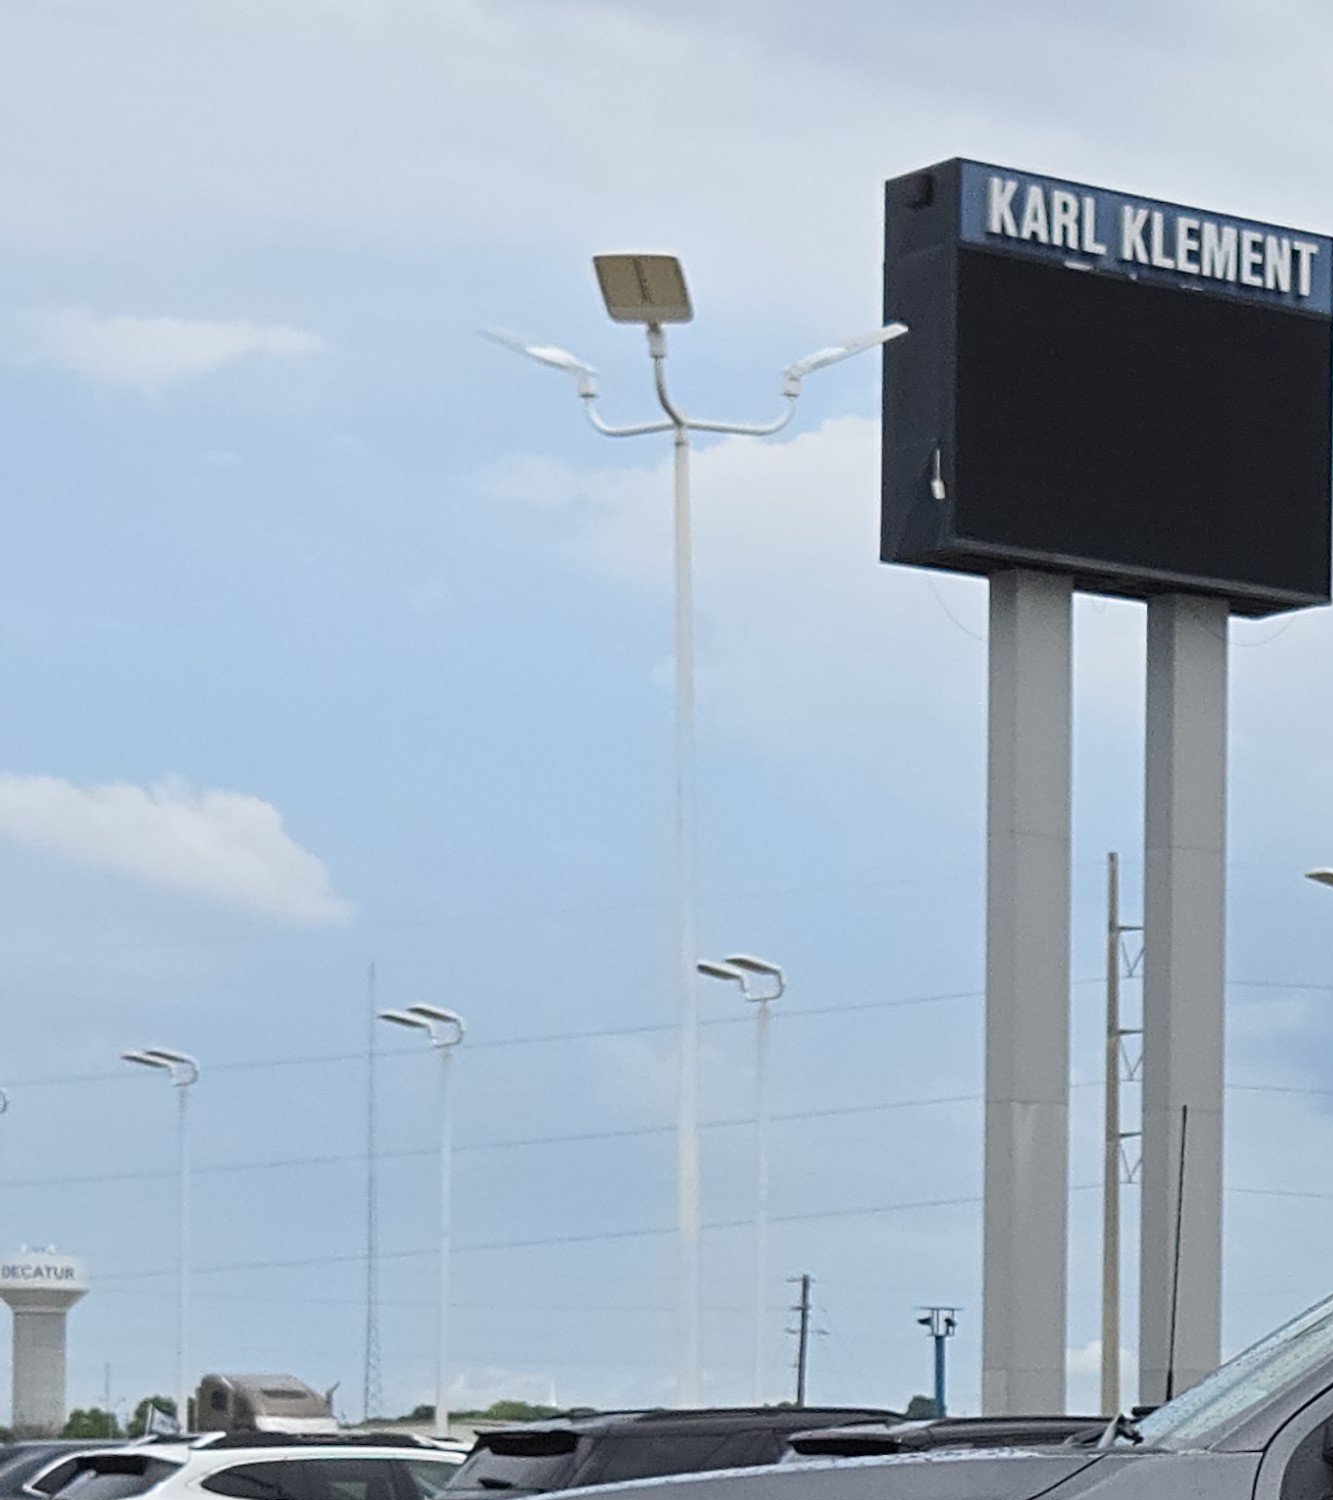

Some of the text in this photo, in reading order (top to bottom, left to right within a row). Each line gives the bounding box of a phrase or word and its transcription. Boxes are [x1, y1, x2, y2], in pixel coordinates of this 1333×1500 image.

[985, 176, 1319, 297] KARL KLEMENT
[1, 1264, 76, 1280] DECATUR
